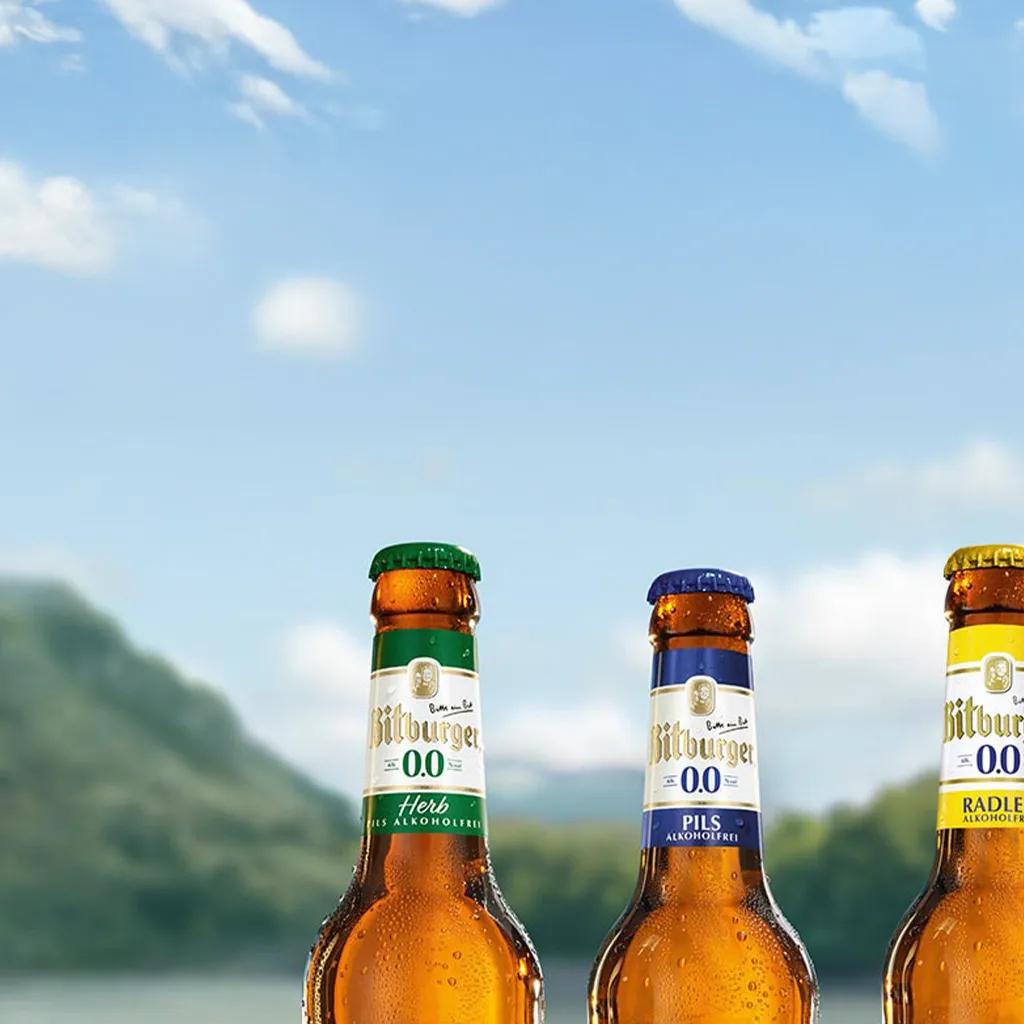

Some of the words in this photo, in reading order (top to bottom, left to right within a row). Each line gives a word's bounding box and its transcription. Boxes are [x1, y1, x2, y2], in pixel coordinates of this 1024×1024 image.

[402, 749, 444, 778] 0.0
[976, 744, 1020, 775] 0.0
[680, 766, 721, 793] 0.0
[399, 795, 449, 817] Herb
[394, 817, 480, 828] ALKOHOLFREI
[683, 815, 721, 831] PILS
[666, 831, 738, 842] ALKOHOLFREI
